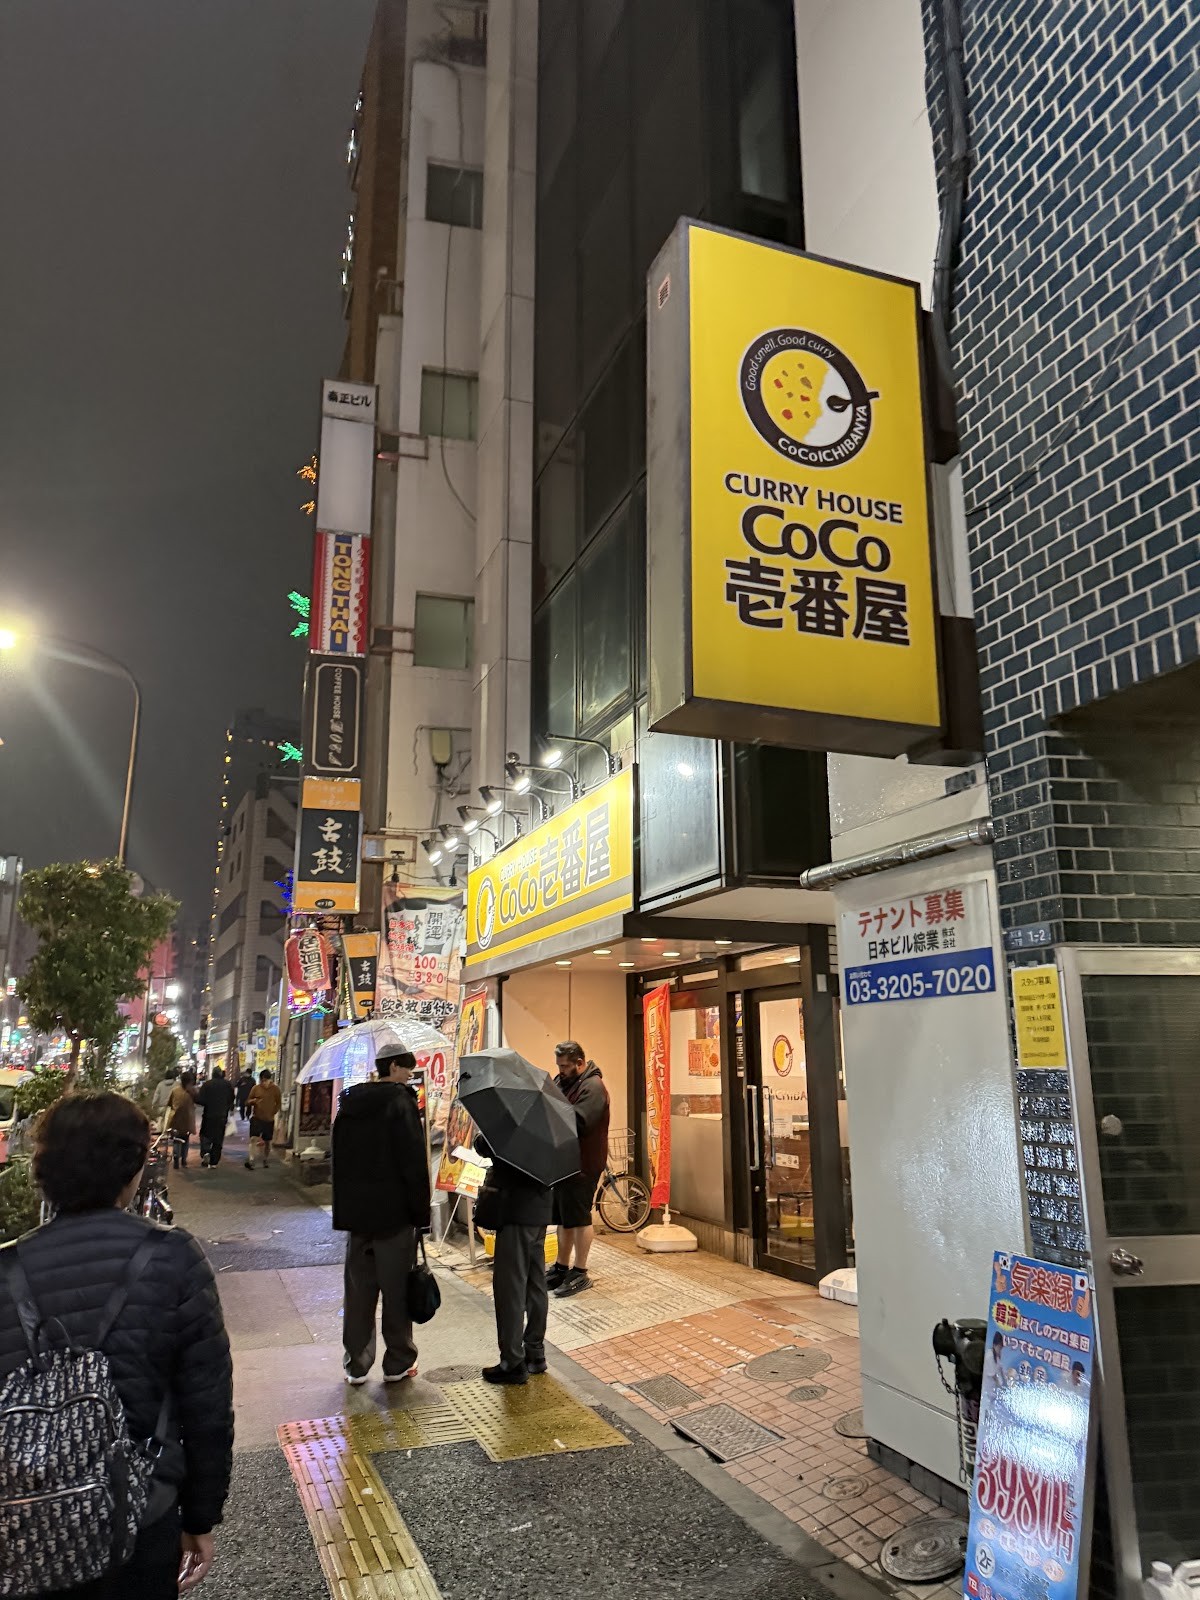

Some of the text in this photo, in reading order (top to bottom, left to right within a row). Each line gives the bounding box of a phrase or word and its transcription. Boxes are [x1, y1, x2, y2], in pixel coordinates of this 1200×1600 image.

[745, 359, 759, 391] Good
[777, 334, 806, 346] Good
[807, 338, 836, 358] curry
[778, 405, 867, 462] CoCoICHIBANYA
[725, 473, 902, 524] CURRY HOUSE
[741, 505, 891, 573] CoCo
[329, 542, 352, 644] TONG THAI
[725, 556, 910, 646] 壱番屋
[332, 667, 342, 719] COFFEE HOUSE
[310, 817, 344, 875] 舌鼓
[425, 912, 443, 940] 開運
[858, 889, 965, 938] テナント募集
[1027, 929, 1046, 942] 1-2
[299, 933, 324, 981] 居酒屋
[414, 955, 437, 969] 100
[868, 929, 940, 960] 日本ビル綜業
[381, 998, 453, 1015] 飲み放題付き
[849, 964, 991, 1003] 03-3205-7020
[1020, 1315, 1090, 1353] ほぐしのプロ集団
